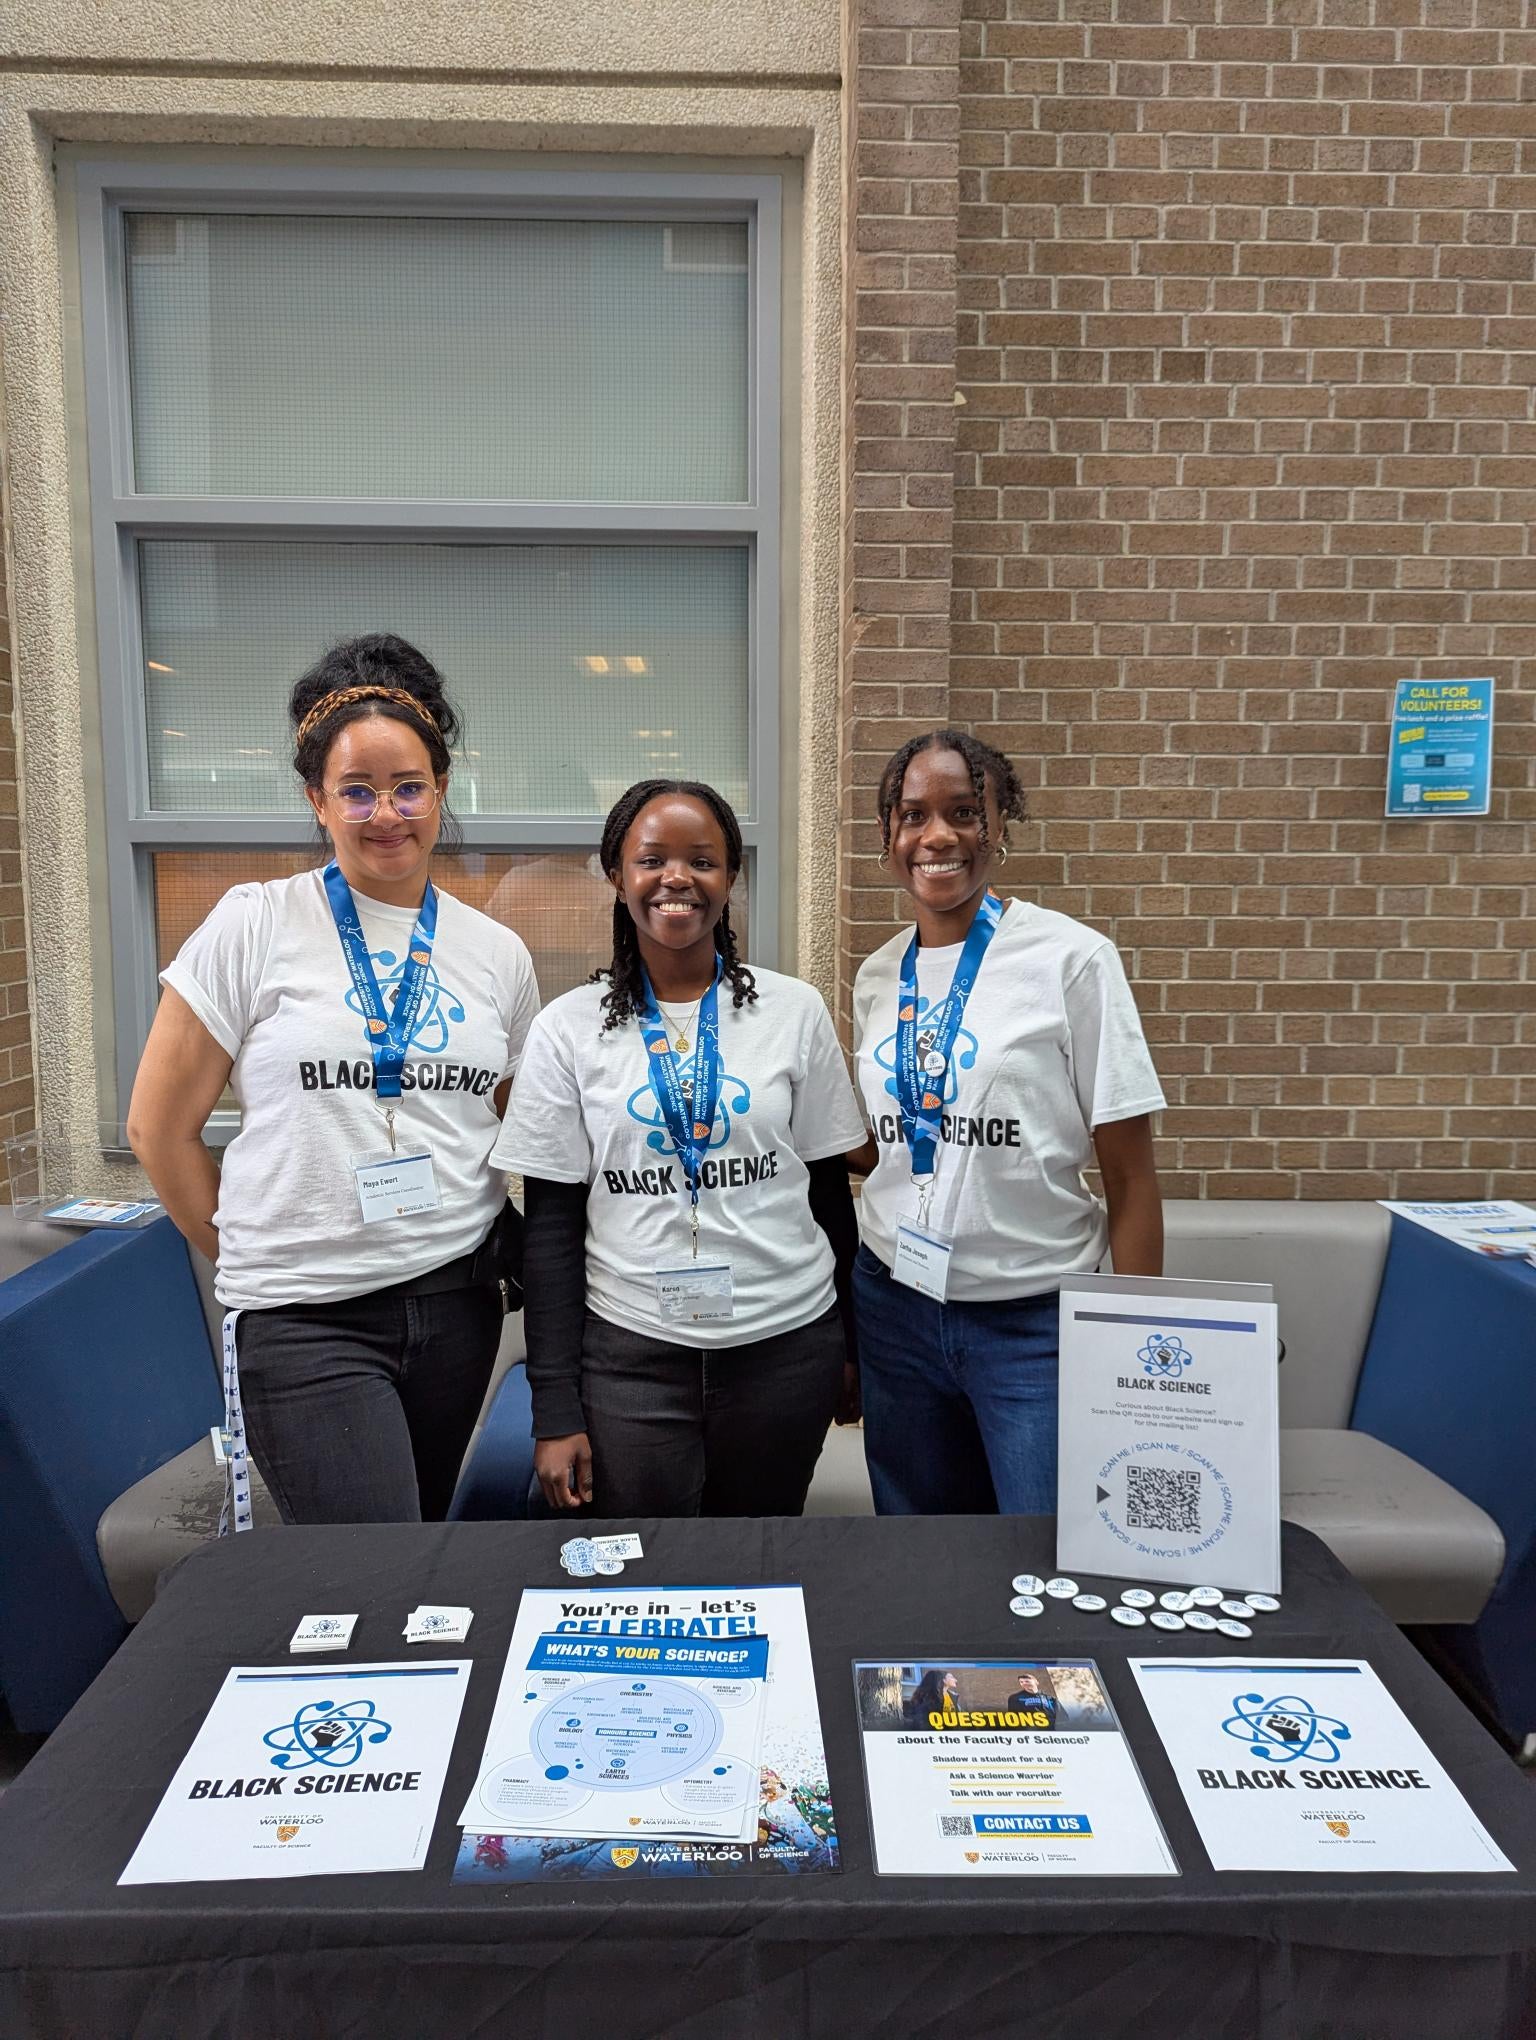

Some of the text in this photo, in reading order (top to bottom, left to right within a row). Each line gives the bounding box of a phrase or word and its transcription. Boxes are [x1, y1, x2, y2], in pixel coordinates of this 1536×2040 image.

[1410, 687, 1469, 699] CALL FOR
[1401, 700, 1482, 712] VOLUNTEERS!
[343, 939, 357, 972] WATERLOO
[403, 966, 420, 1017] FACULTY SCIENCE
[416, 967, 426, 1000] UNIVERSITY
[357, 981, 372, 1017] UNIVERSITY
[366, 993, 378, 1017] FACULTY
[402, 1010, 416, 1042] WATERLOO
[939, 1000, 954, 1037] WATERLOO
[697, 1036, 705, 1069] WATERLOO
[299, 1060, 498, 1096] BLAC SCIENCE
[659, 1056, 669, 1080] FACULTY
[668, 1088, 678, 1113] SCIENCE
[665, 1054, 679, 1090] UNIVERSITY
[677, 1102, 691, 1140] WATERLOO
[694, 1081, 702, 1120] UNIVERSITY
[909, 1072, 920, 1111] WATERLOO
[363, 1179, 379, 1189] Maya
[603, 1166, 678, 1196] BLACK
[1117, 1377, 1212, 1395] BLACK SCIENCE
[1116, 1401, 1217, 1415] Curious about Black Science?
[1121, 1409, 1133, 1417] QR
[1134, 1411, 1151, 1419] code
[1174, 1415, 1202, 1423] website
[1218, 1418, 1233, 1426] sign
[1159, 1422, 1184, 1430] mailing
[1099, 1442, 1233, 1558] SCAN ME SCAN ME SCAN ME SCAN ME SCAN ME SCAN ME SCAN ME
[560, 1603, 639, 1617] You're
[648, 1602, 670, 1615] in
[701, 1600, 757, 1614] let's
[546, 1643, 749, 1663] WHAT'S YOUR SCIENCE?
[928, 1711, 1050, 1730] QUESTIONS
[897, 1736, 1090, 1746] about the Faculty of Science?
[932, 1755, 968, 1763] Shadow
[1045, 1756, 1063, 1764] day
[188, 1771, 422, 1800] BLACK SCIENCE
[1196, 1769, 1432, 1790] BLACK SCIENCE
[983, 1817, 1080, 1830] CONTACT US
[641, 1851, 742, 1863] WATERLOO
